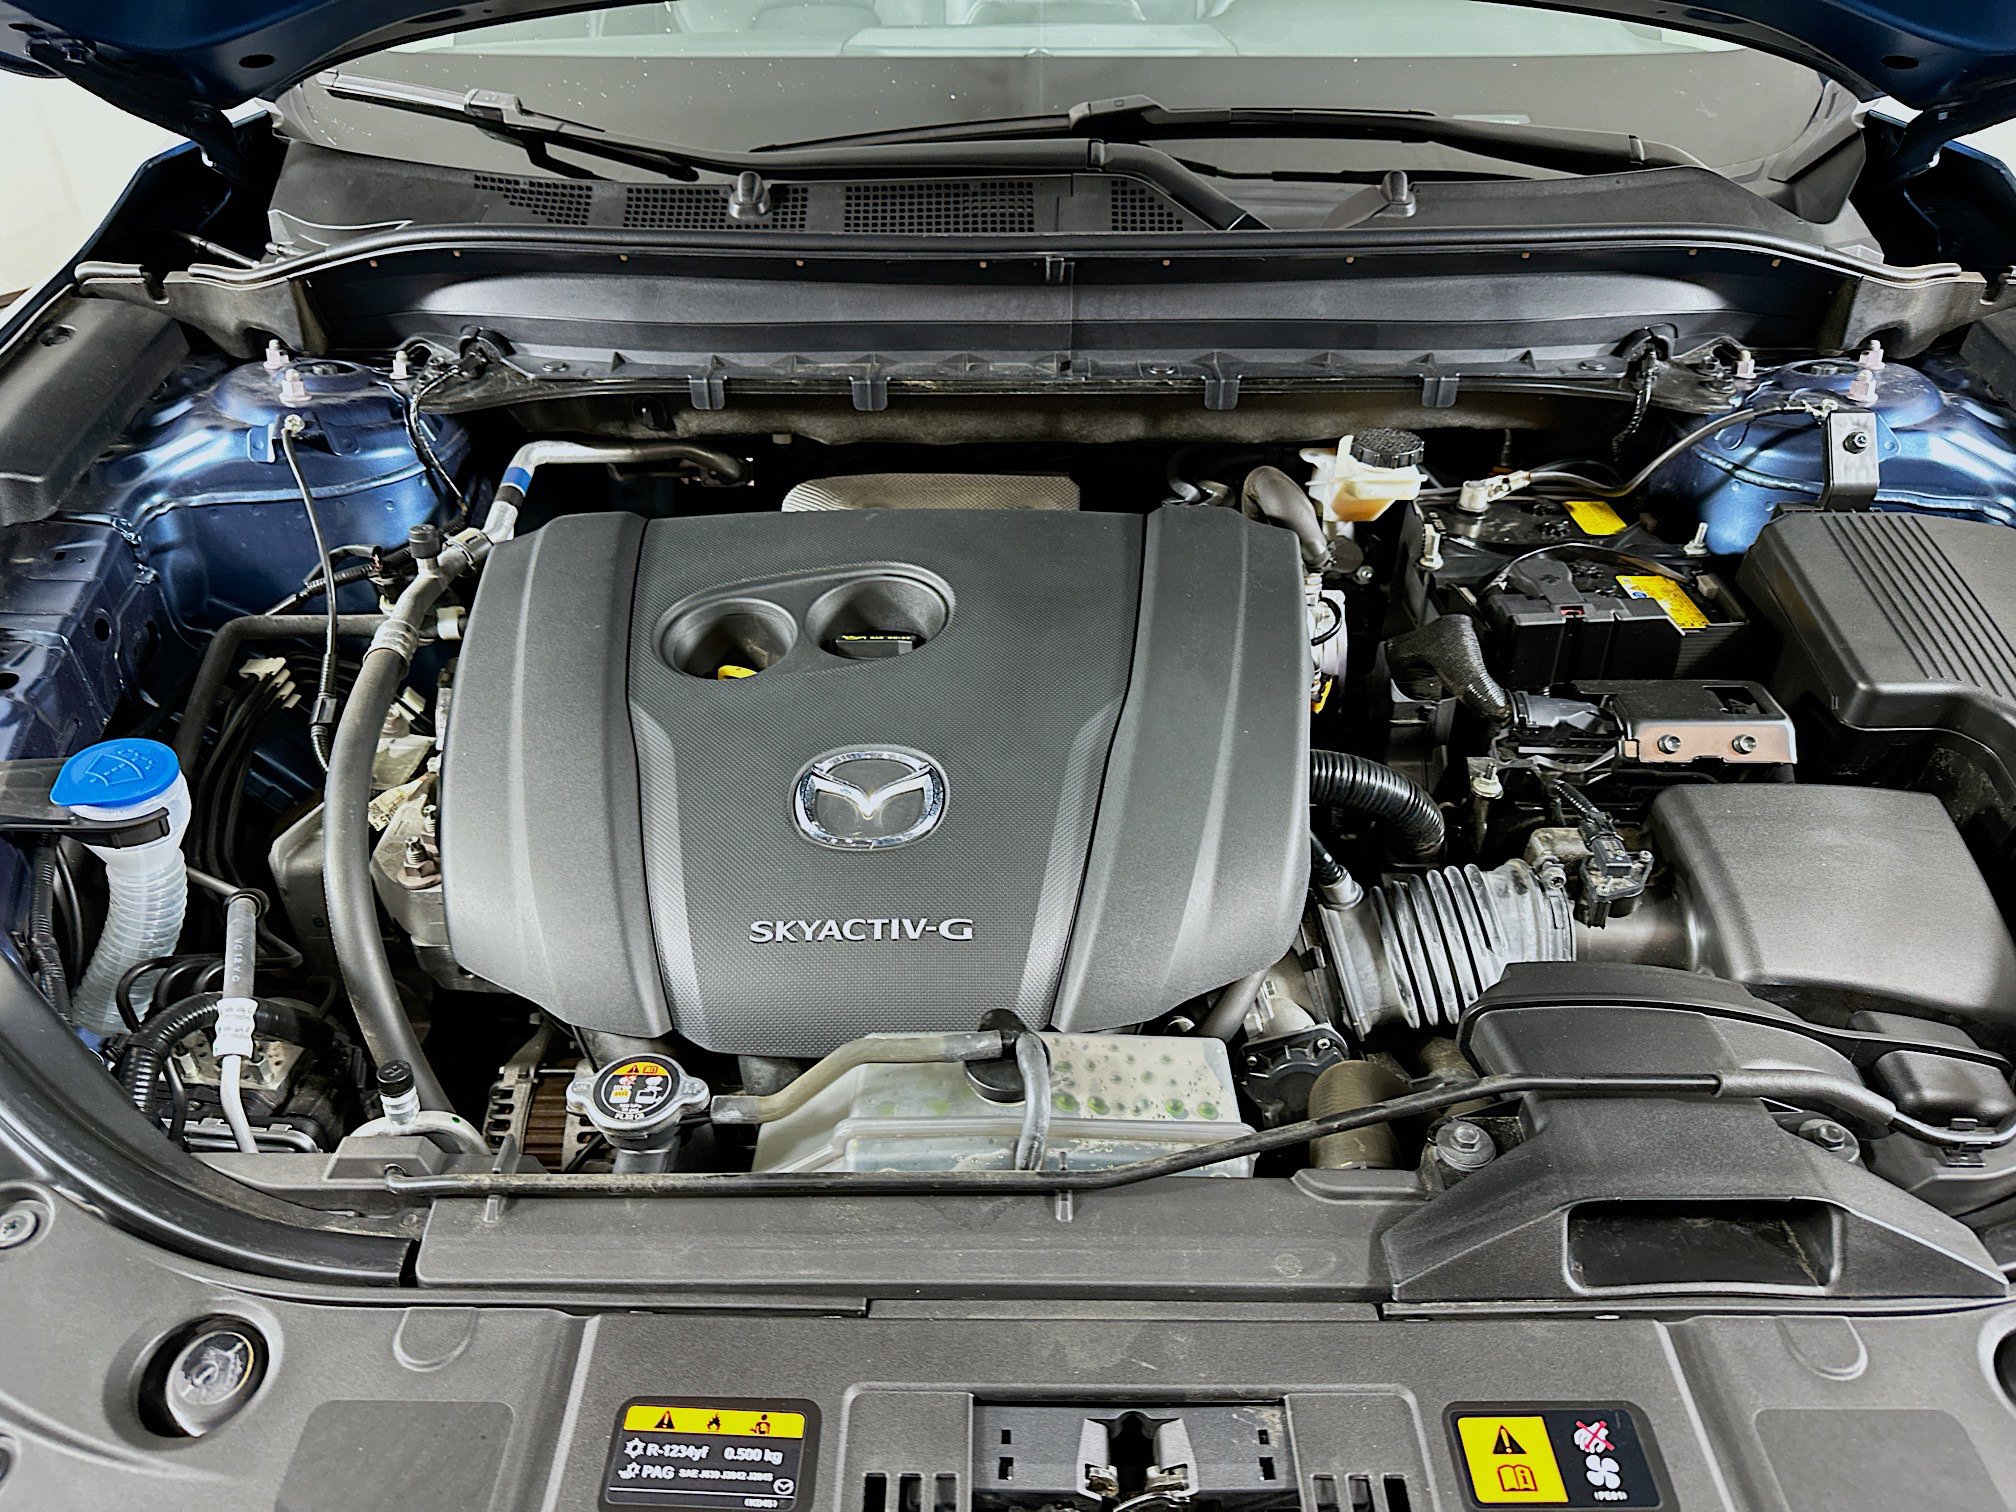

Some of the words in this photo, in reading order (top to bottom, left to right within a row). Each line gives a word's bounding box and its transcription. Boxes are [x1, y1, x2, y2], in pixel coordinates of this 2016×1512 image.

[748, 918, 973, 943] SKYACTIV-G
[645, 1442, 710, 1462] R-1234yf
[723, 1445, 763, 1461] 0.500
[763, 1448, 784, 1465] kg
[640, 1464, 676, 1479] PAG
